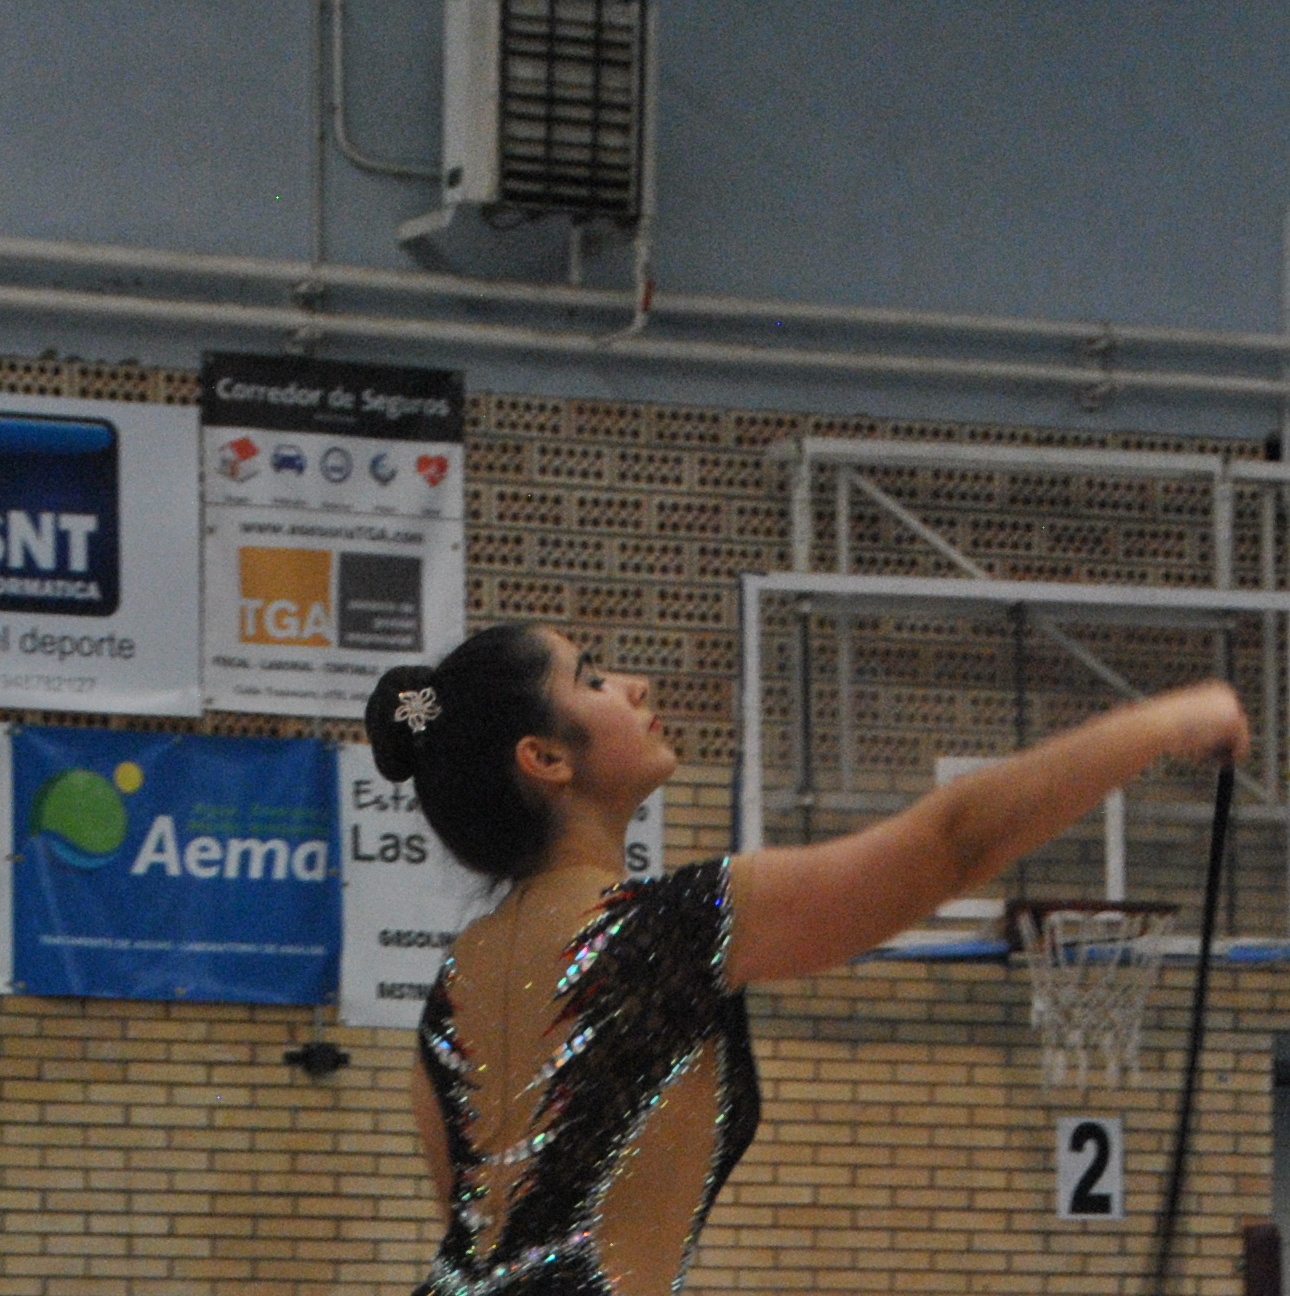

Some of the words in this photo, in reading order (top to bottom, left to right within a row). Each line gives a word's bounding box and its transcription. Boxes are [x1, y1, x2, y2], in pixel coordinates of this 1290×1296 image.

[326, 385, 356, 409] de
[360, 388, 451, 421] Seguros
[241, 599, 334, 640] TGA
[18, 626, 137, 661] deporte
[130, 814, 328, 882] Aema
[351, 823, 427, 864] Las
[1068, 1121, 1113, 1215] 2
